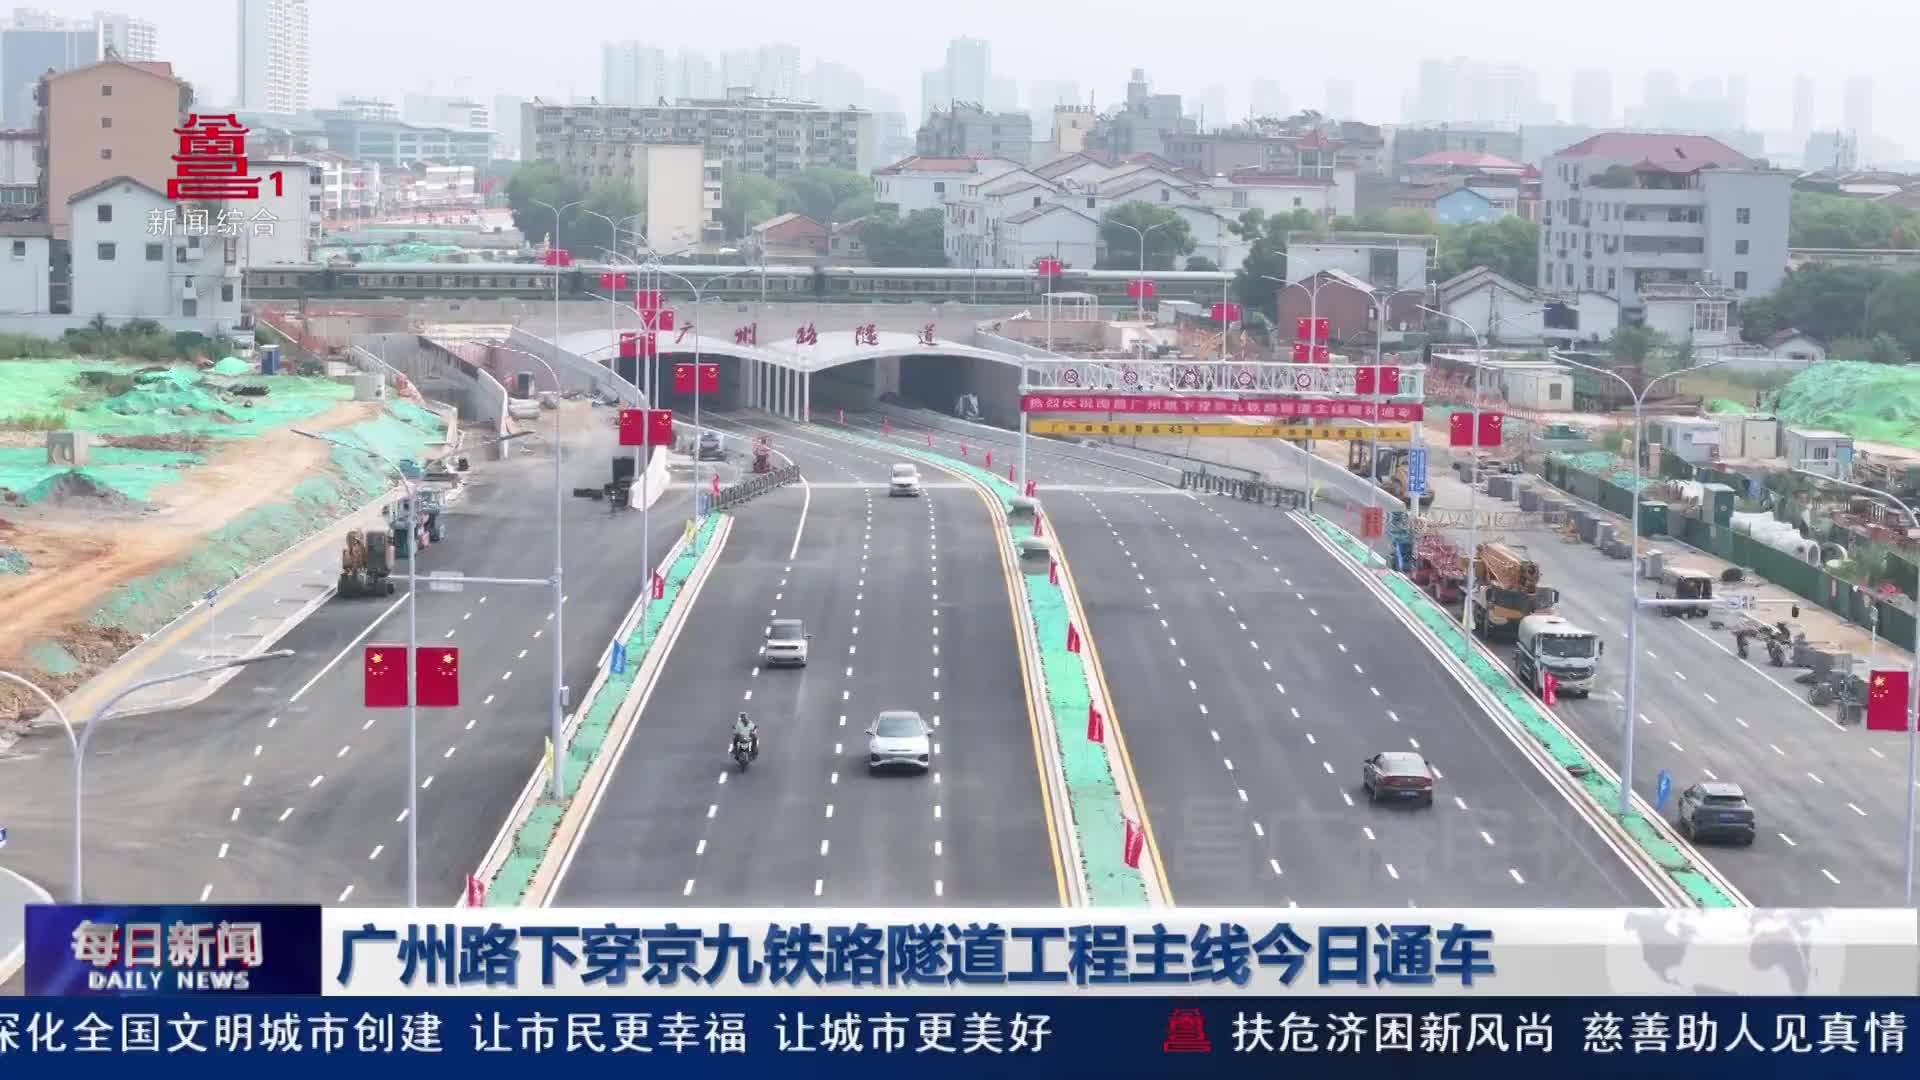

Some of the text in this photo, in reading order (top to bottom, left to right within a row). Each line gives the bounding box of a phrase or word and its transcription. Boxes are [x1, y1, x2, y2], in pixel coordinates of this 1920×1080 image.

[674, 322, 938, 347] 广州路隧道
